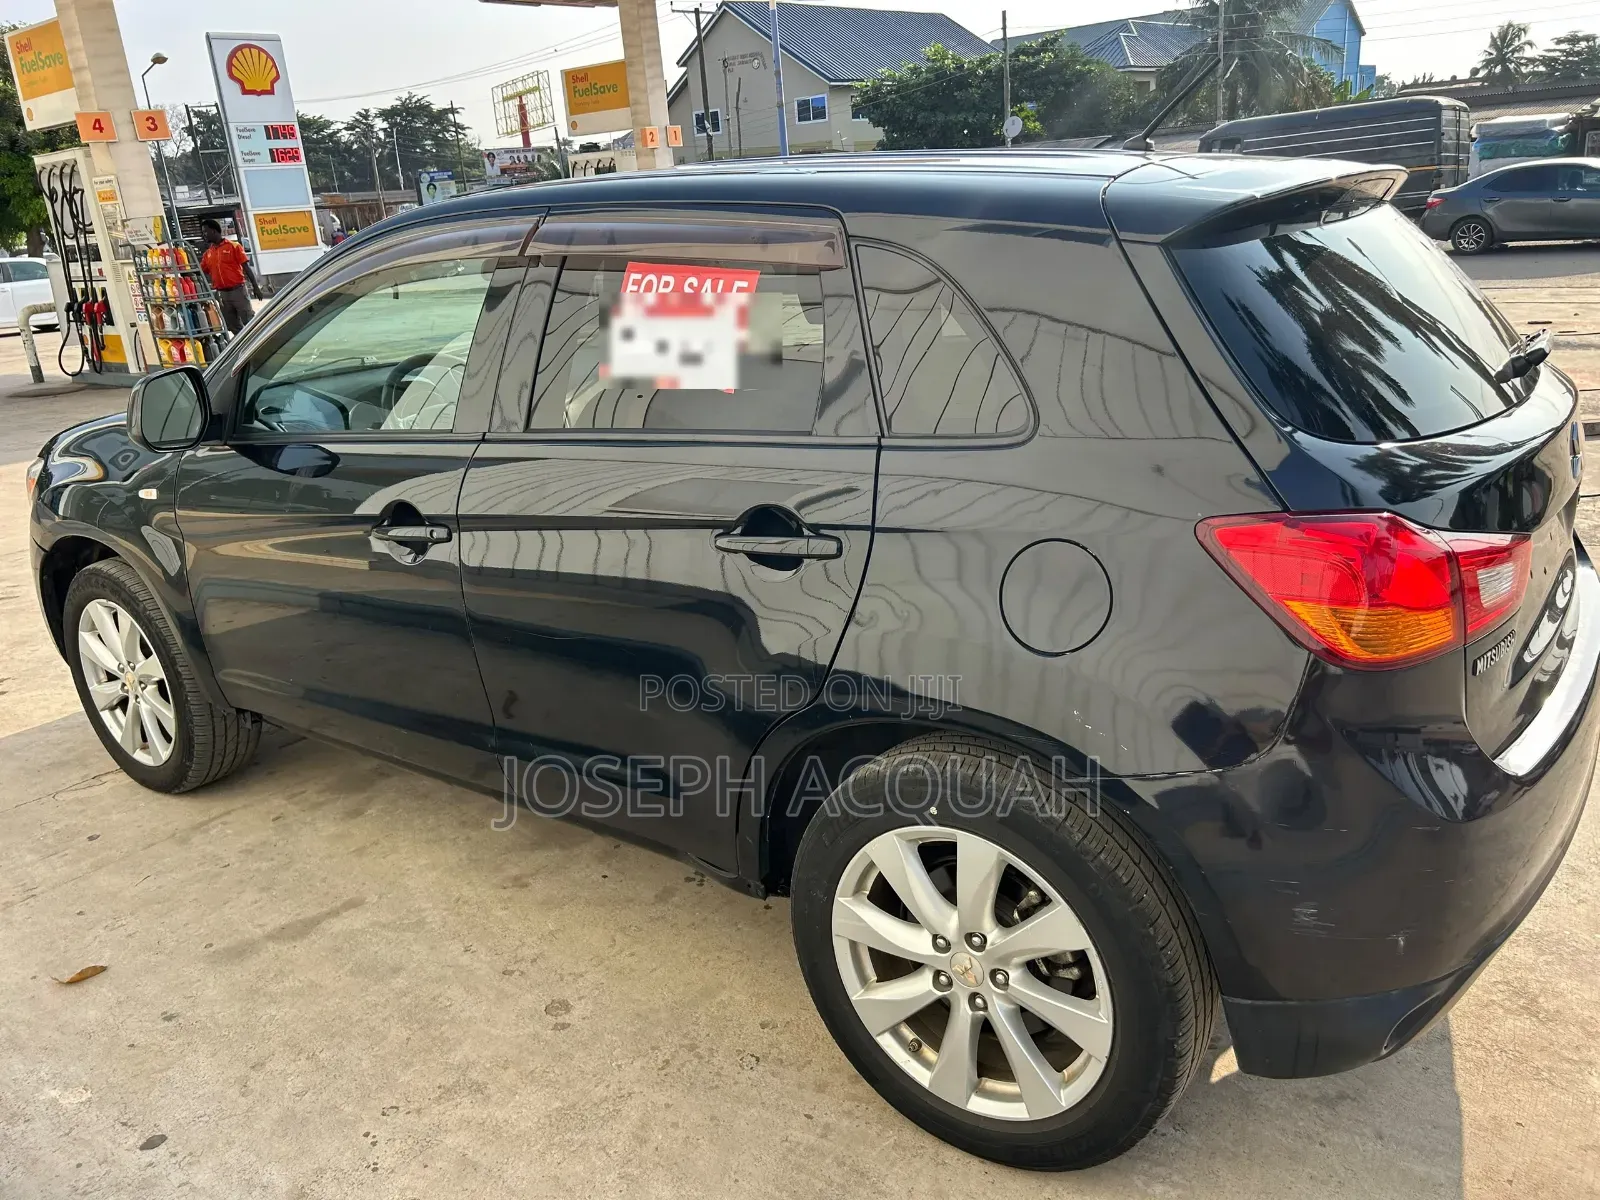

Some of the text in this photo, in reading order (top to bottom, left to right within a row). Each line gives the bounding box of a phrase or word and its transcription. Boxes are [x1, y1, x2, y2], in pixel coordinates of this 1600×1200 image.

[16, 37, 32, 54] Shell
[19, 50, 64, 75] FuelSave
[571, 72, 589, 84] Shell
[572, 82, 618, 98] FuelSave
[92, 118, 104, 133] 4
[145, 116, 158, 131] 3
[649, 131, 655, 142] 2
[673, 130, 678, 141] 1
[258, 217, 277, 225] Shell
[260, 224, 309, 236] FuelSave
[625, 273, 675, 295] FOR
[1472, 629, 1516, 676] MITSUBISH
